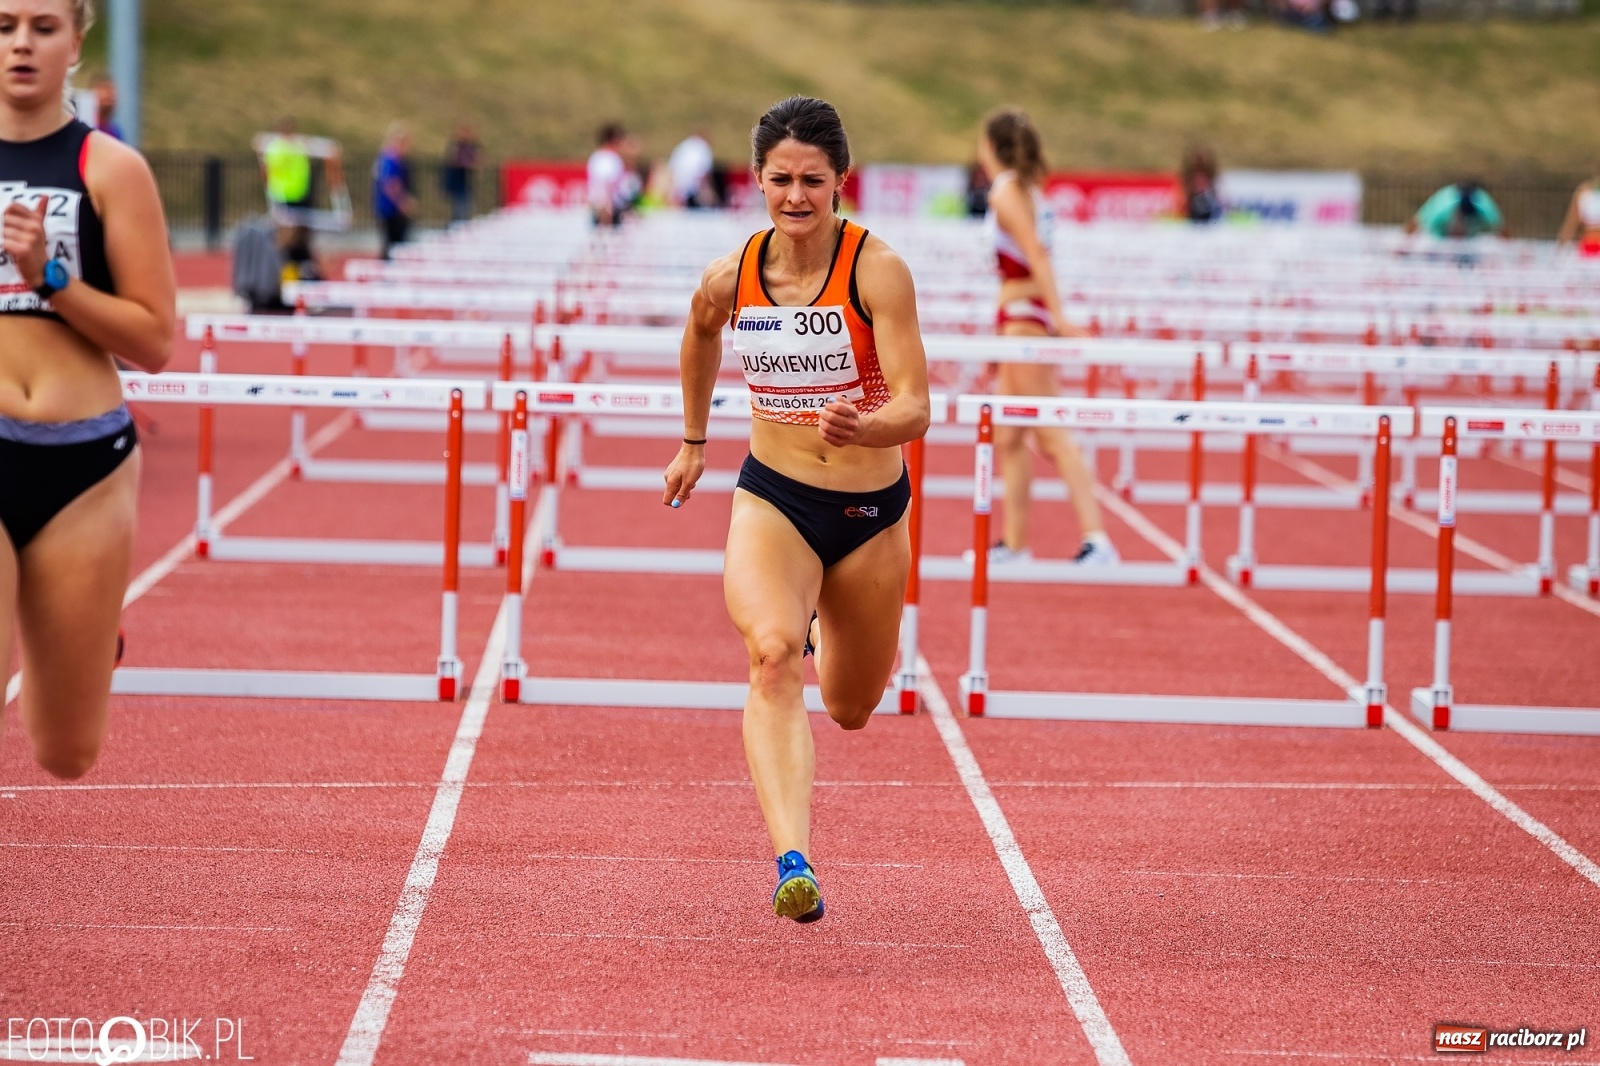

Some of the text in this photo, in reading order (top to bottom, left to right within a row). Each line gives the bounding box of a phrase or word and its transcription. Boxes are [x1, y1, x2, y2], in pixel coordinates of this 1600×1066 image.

[794, 311, 843, 336] 300
[742, 352, 851, 373] JUŚKIEWICZ
[758, 396, 816, 409] RACIBÓRZ
